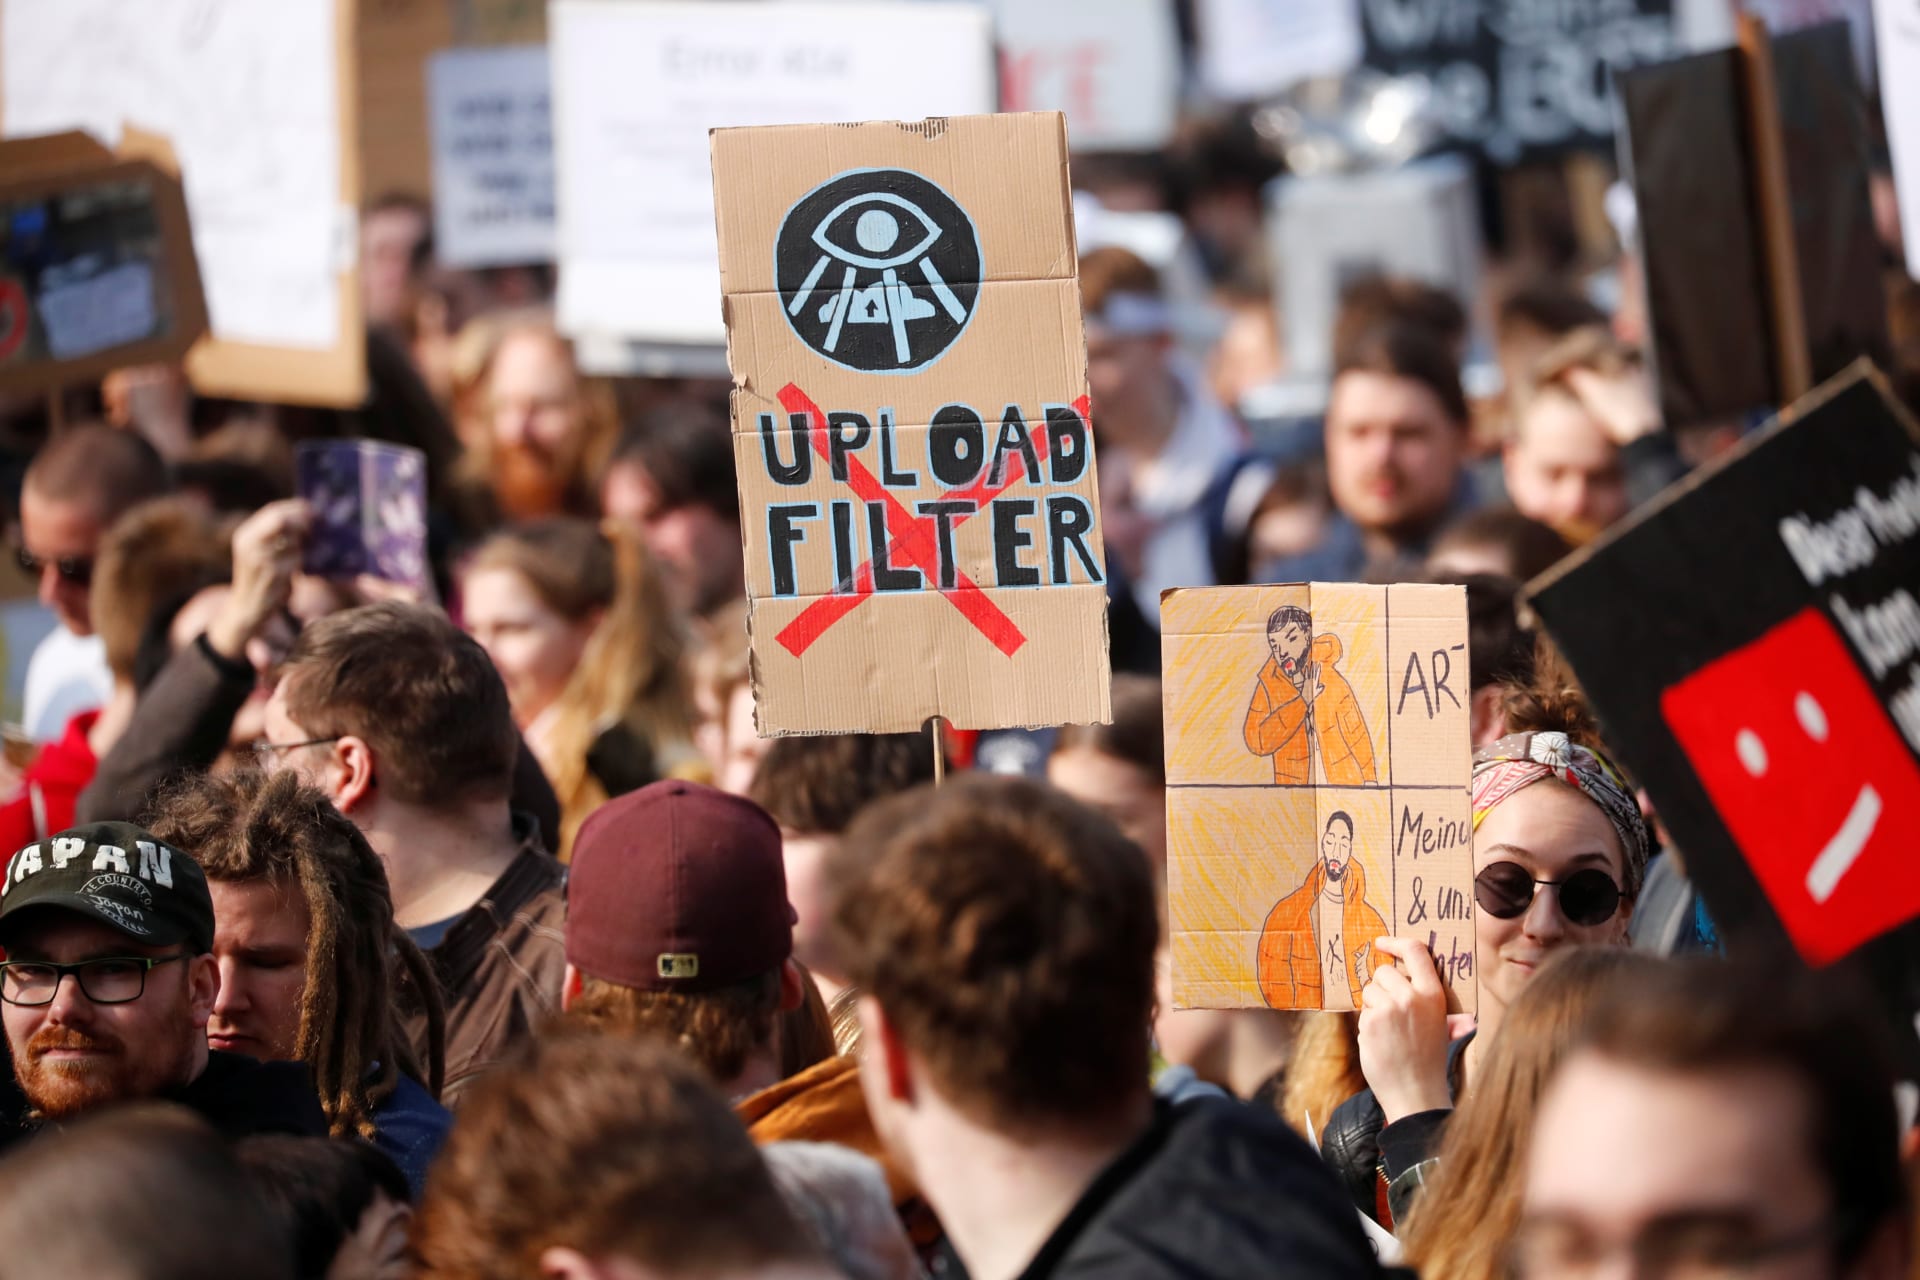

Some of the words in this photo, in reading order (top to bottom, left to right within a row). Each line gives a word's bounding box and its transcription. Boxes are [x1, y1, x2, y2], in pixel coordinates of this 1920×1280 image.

[756, 401, 1092, 491] UPLOAD
[766, 491, 1106, 600] FILTER
[1407, 876, 1428, 927] &
